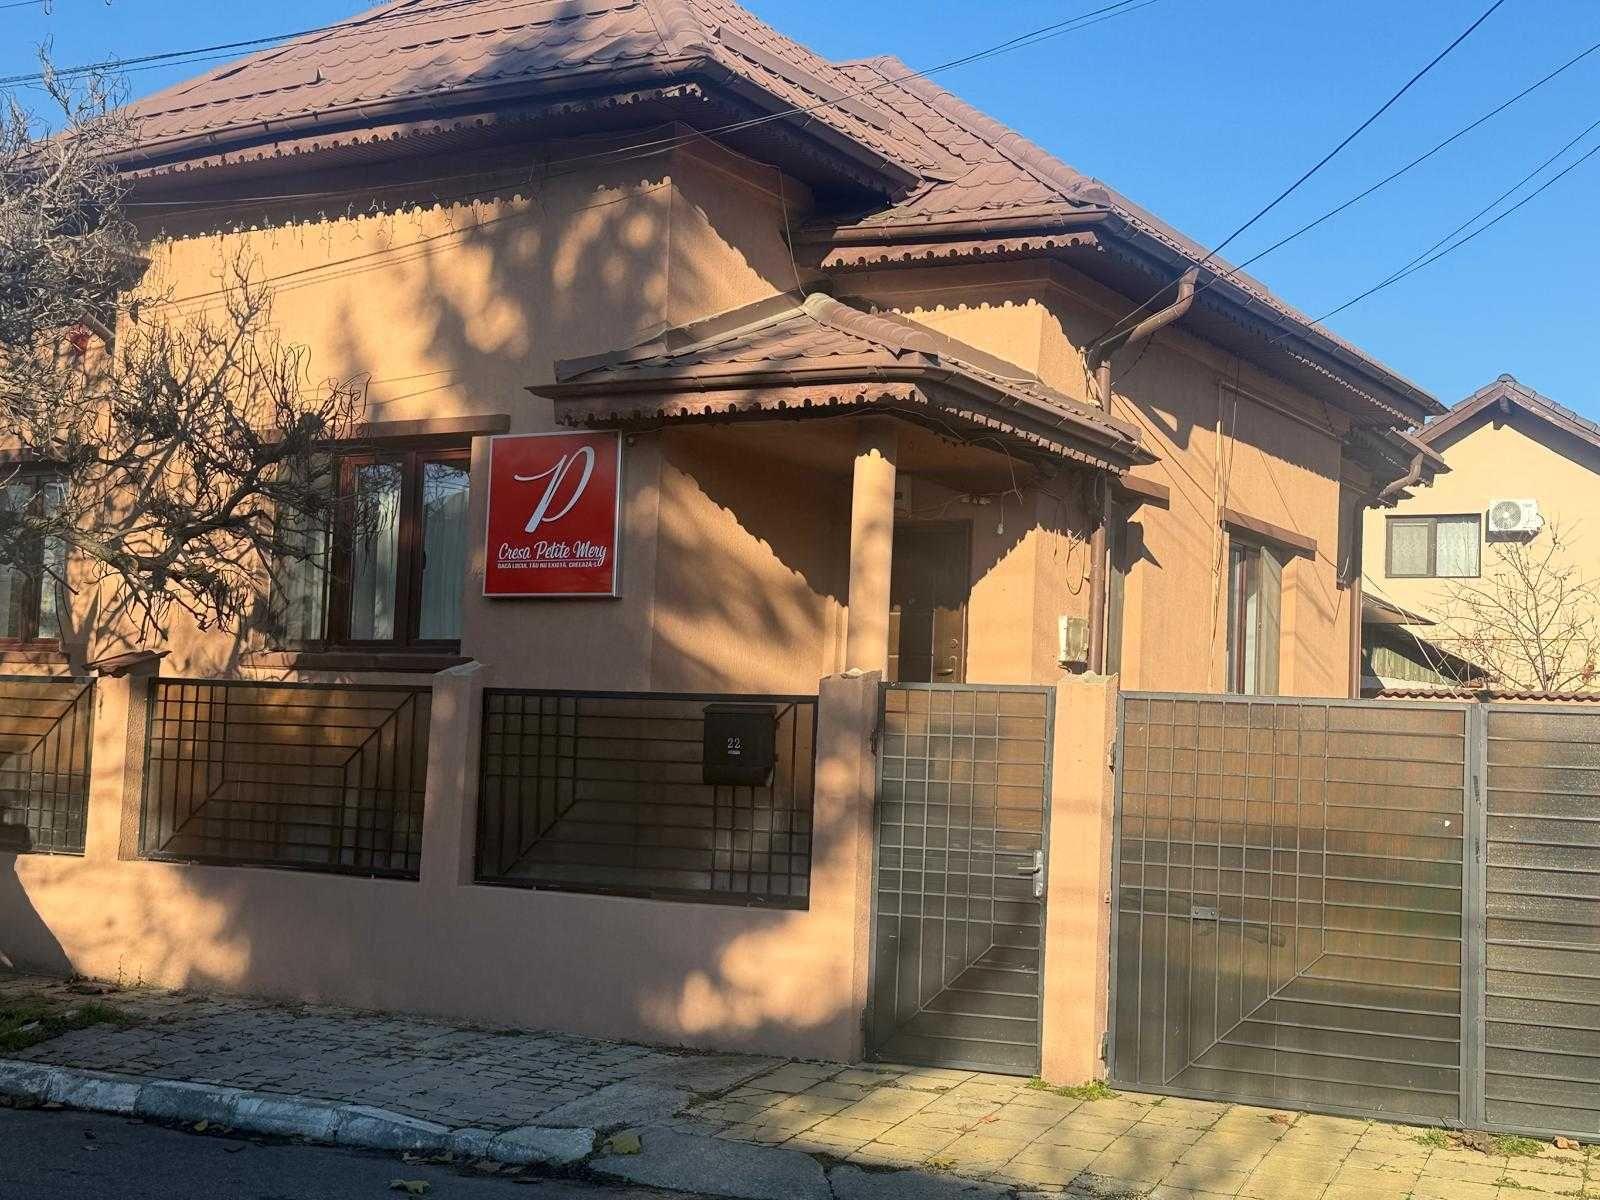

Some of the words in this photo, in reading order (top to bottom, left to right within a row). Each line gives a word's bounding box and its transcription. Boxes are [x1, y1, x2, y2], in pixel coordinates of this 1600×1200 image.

[499, 542, 531, 559] Cresa
[534, 541, 571, 559] Petite
[573, 541, 607, 567] Mery
[728, 737, 740, 748] 22
